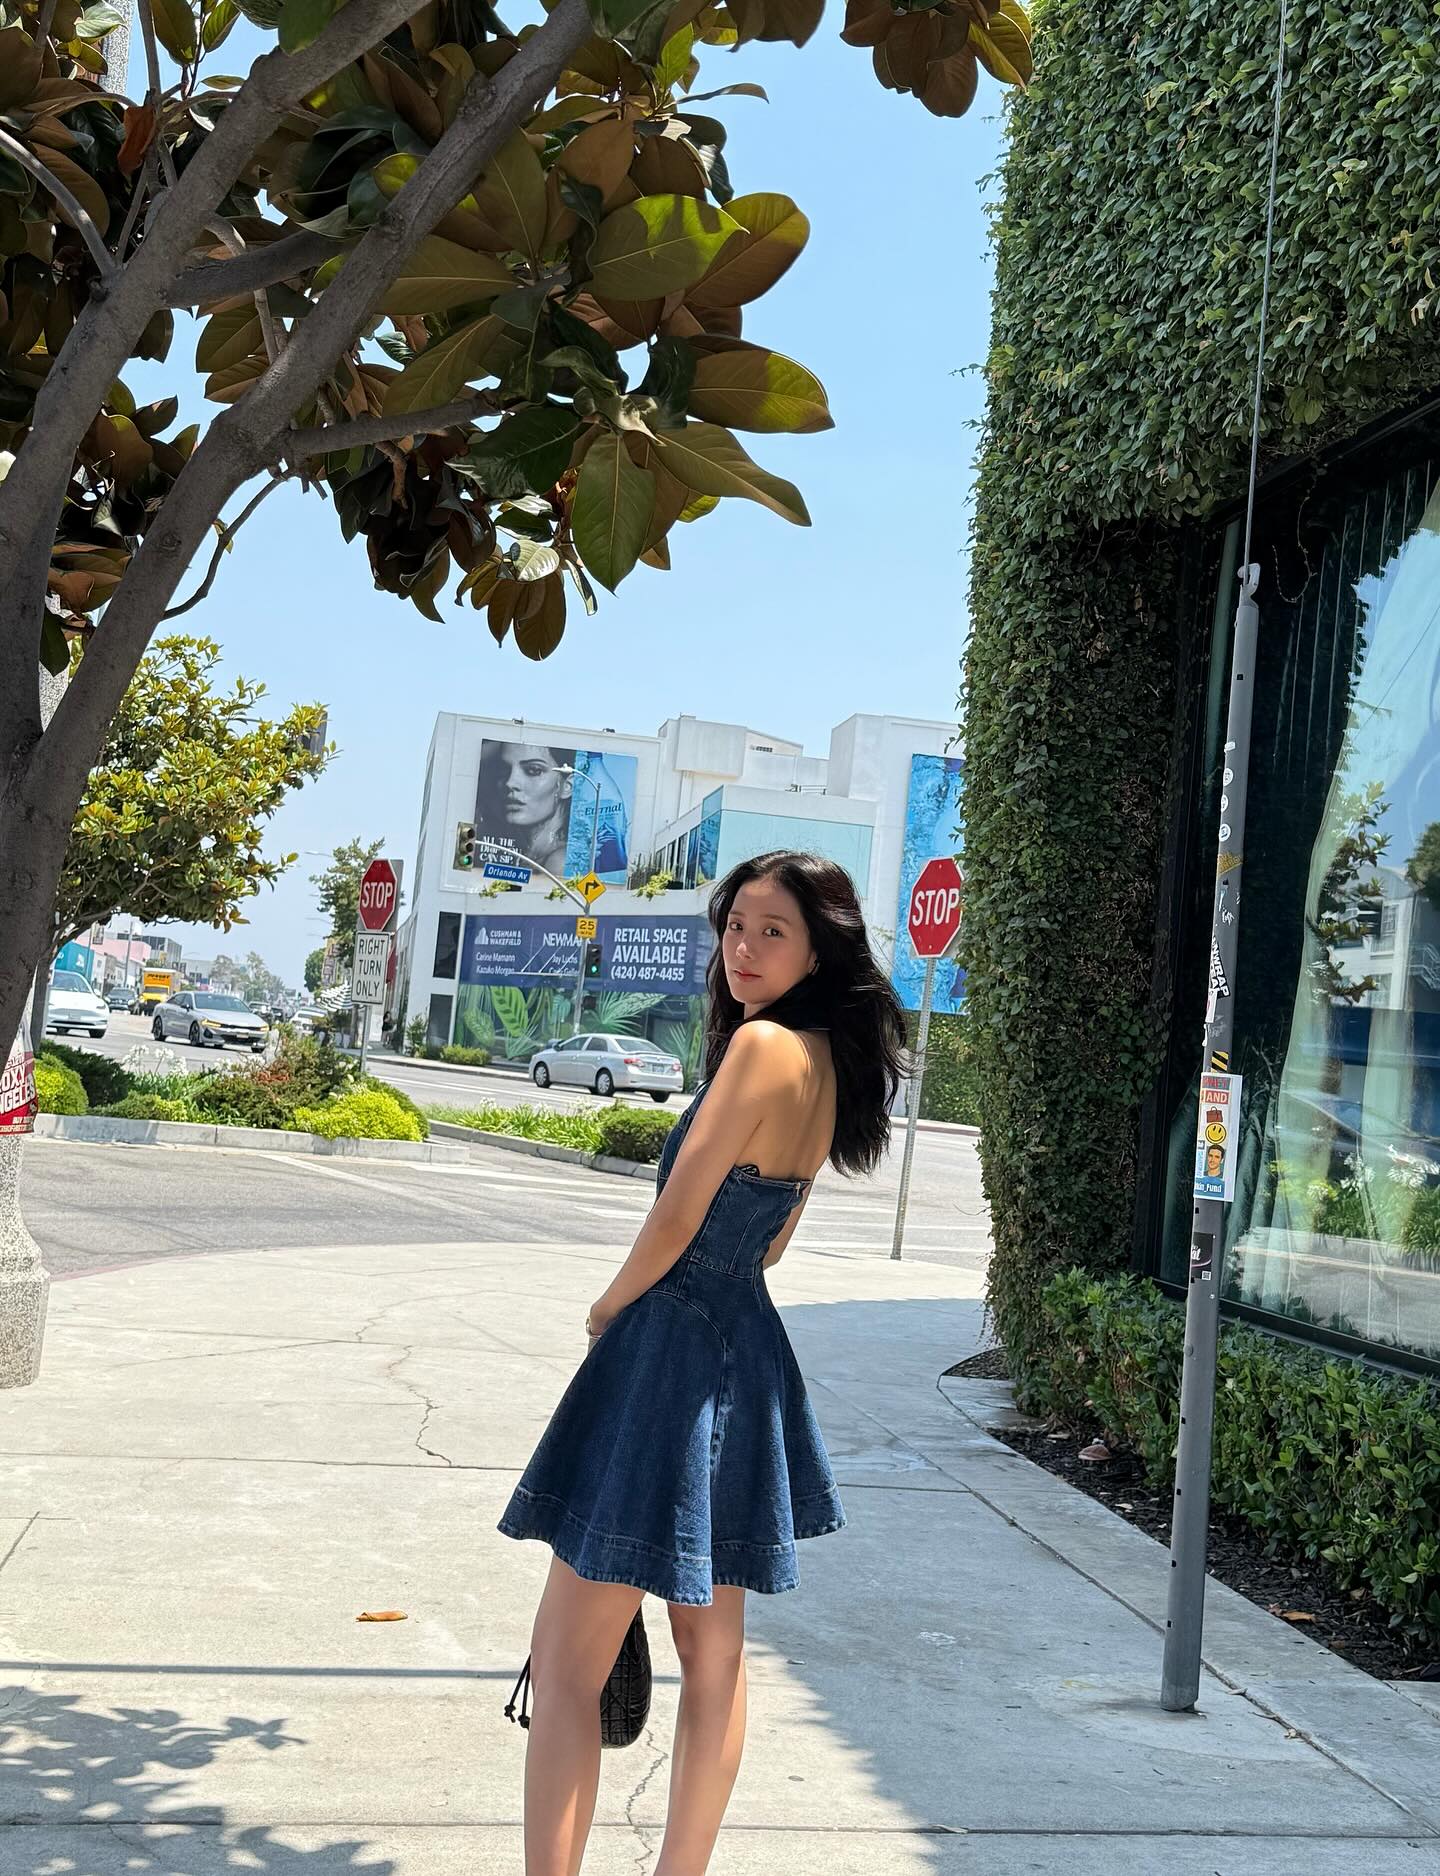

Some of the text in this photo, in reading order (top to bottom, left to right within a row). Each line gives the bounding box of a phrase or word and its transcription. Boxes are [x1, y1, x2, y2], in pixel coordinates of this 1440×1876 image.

[584, 803, 622, 816] Etrnal
[488, 866, 517, 879] Orlando
[362, 882, 393, 909] STOP
[912, 888, 960, 926] STOP
[579, 919, 595, 931] 25
[490, 930, 517, 938] CUSHMAN
[490, 938, 522, 946] WAKEFIELD
[614, 927, 688, 943] RETAIL SPACE
[359, 939, 385, 955] RIGHT
[612, 945, 687, 965] AVAILABLE
[359, 959, 382, 976] TURN
[611, 966, 685, 981] (424) 487-4455
[356, 980, 380, 997] ONLY
